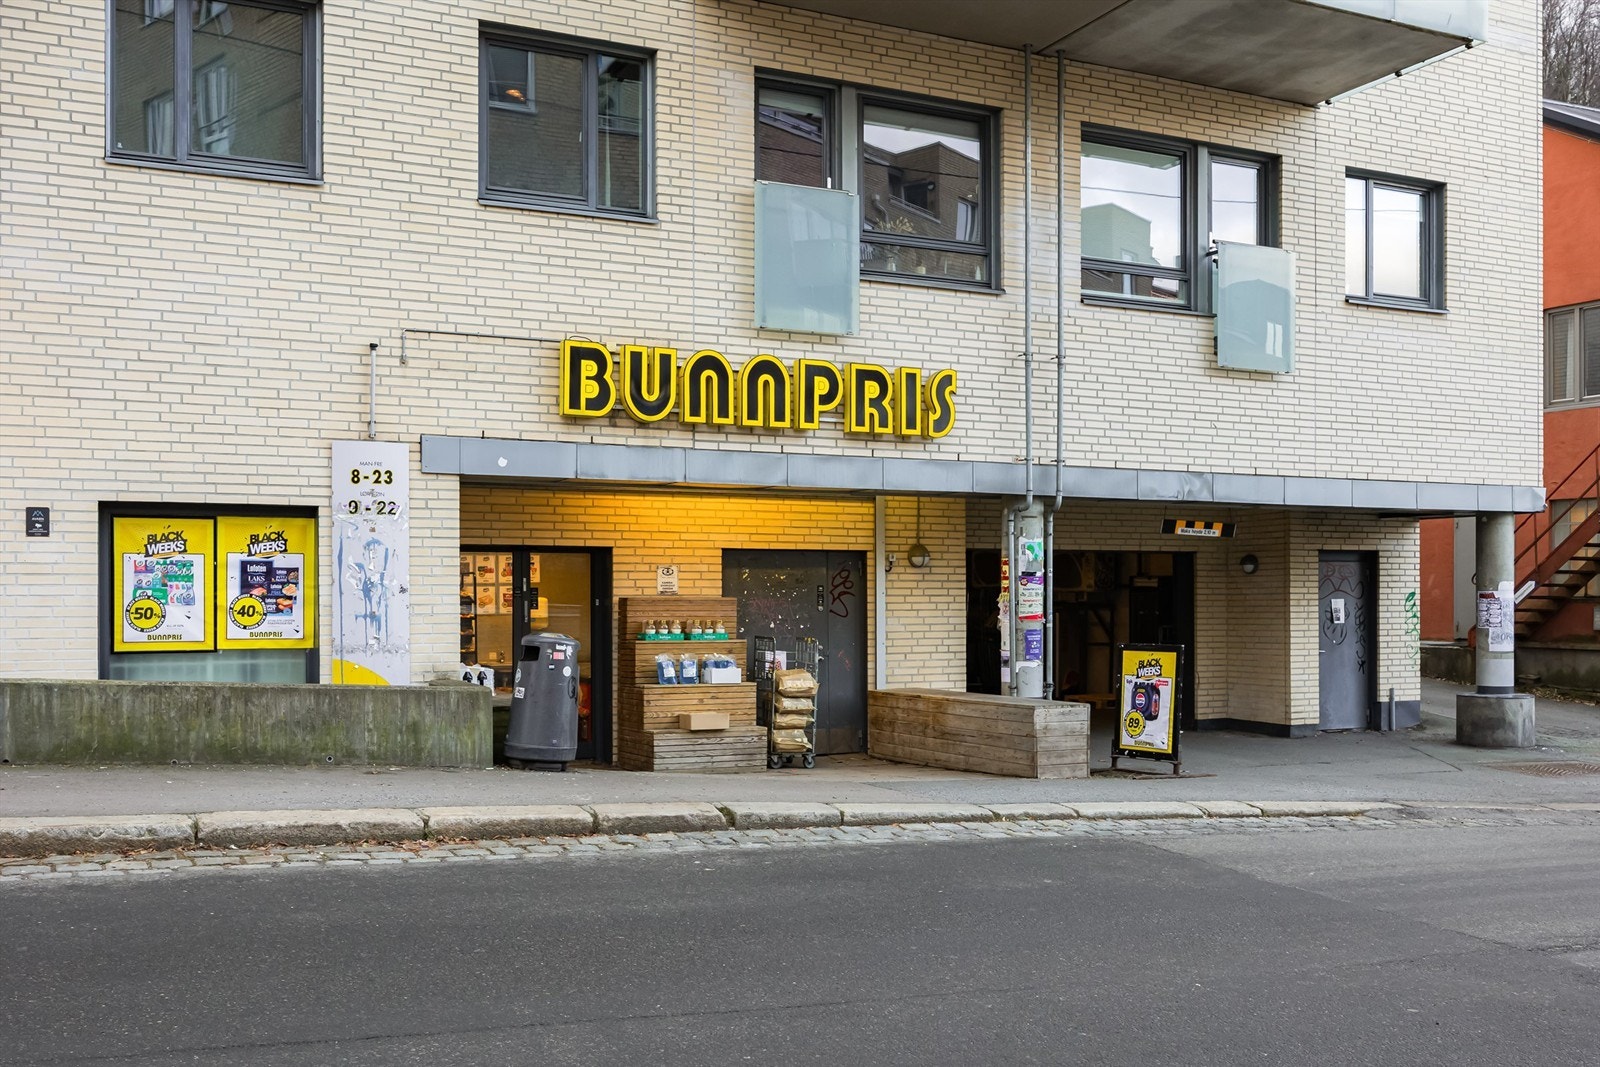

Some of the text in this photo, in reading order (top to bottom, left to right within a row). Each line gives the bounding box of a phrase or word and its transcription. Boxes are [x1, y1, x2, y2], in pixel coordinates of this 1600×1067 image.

[559, 339, 957, 439] BUNNPRIS
[147, 530, 184, 544] BLACK
[249, 530, 285, 544] BLACK
[146, 540, 185, 555] WEEKS
[249, 540, 286, 555] WEEKS
[1138, 658, 1162, 668] BLACK
[1138, 667, 1161, 678] WEEKS
